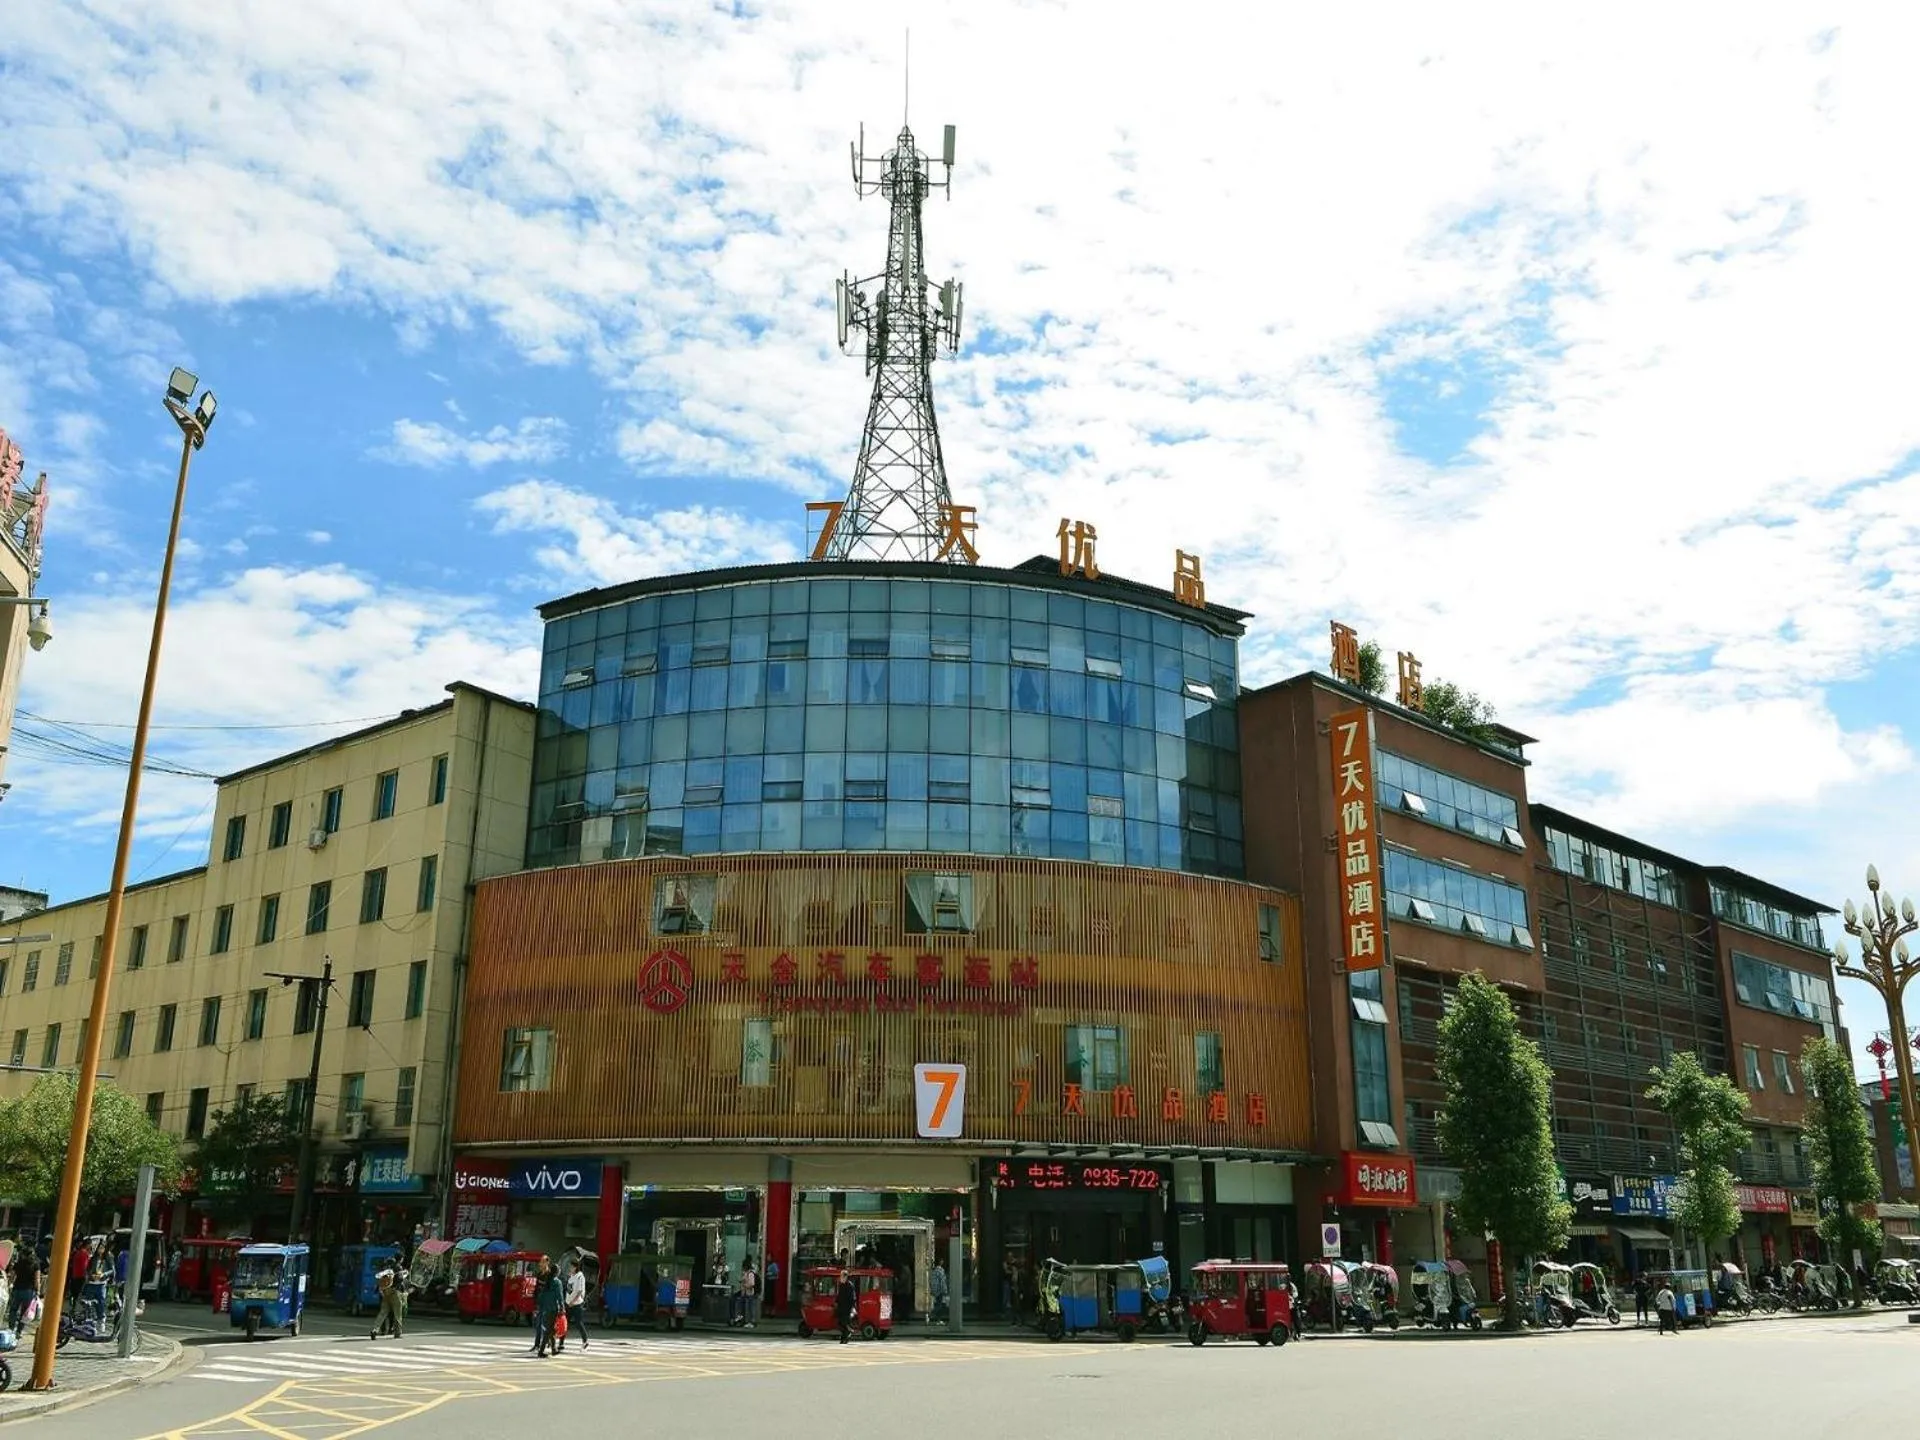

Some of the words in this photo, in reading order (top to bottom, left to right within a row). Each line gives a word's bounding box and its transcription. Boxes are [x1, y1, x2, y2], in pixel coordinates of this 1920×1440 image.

[1337, 721, 1376, 958] 7天优品酒店
[923, 1071, 961, 1130] 7
[1012, 1080, 1268, 1127] 7天优品酒店
